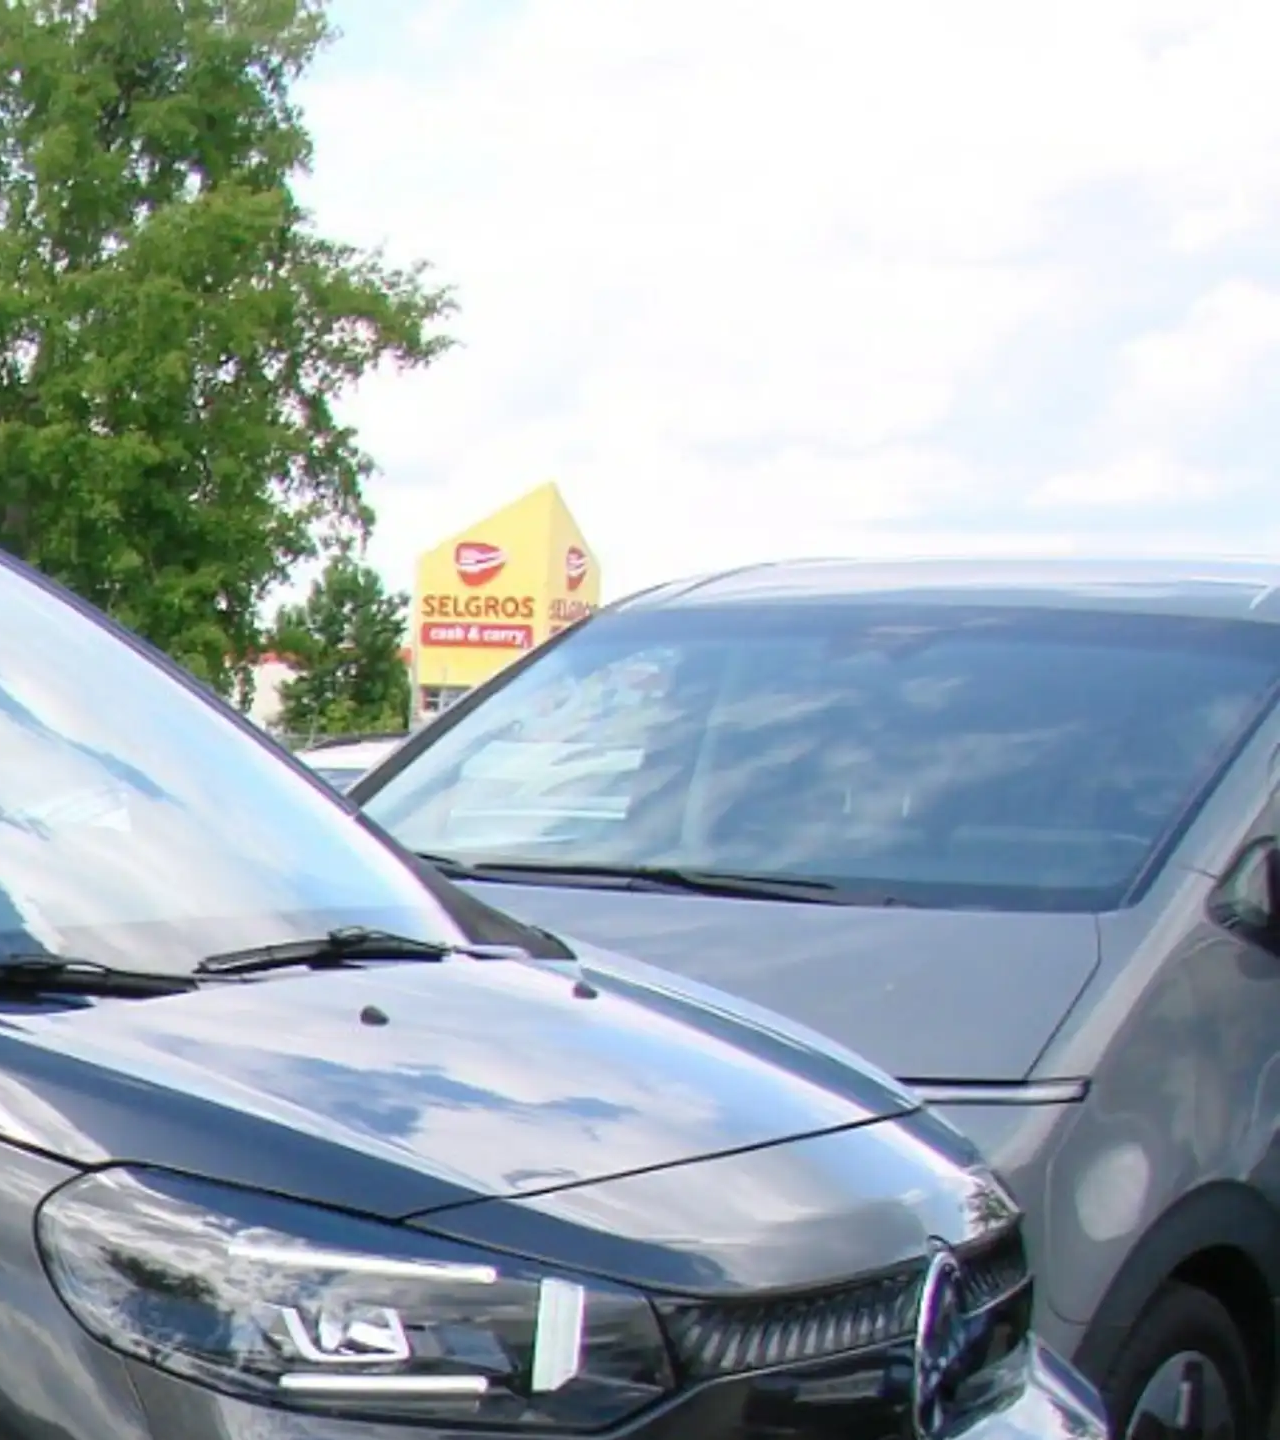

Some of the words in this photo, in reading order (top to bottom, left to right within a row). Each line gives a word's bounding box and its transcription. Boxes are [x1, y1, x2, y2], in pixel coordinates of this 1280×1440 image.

[422, 594, 534, 619] SELGROS
[429, 624, 465, 641] cash
[467, 625, 480, 642] &
[482, 629, 527, 646] carry
